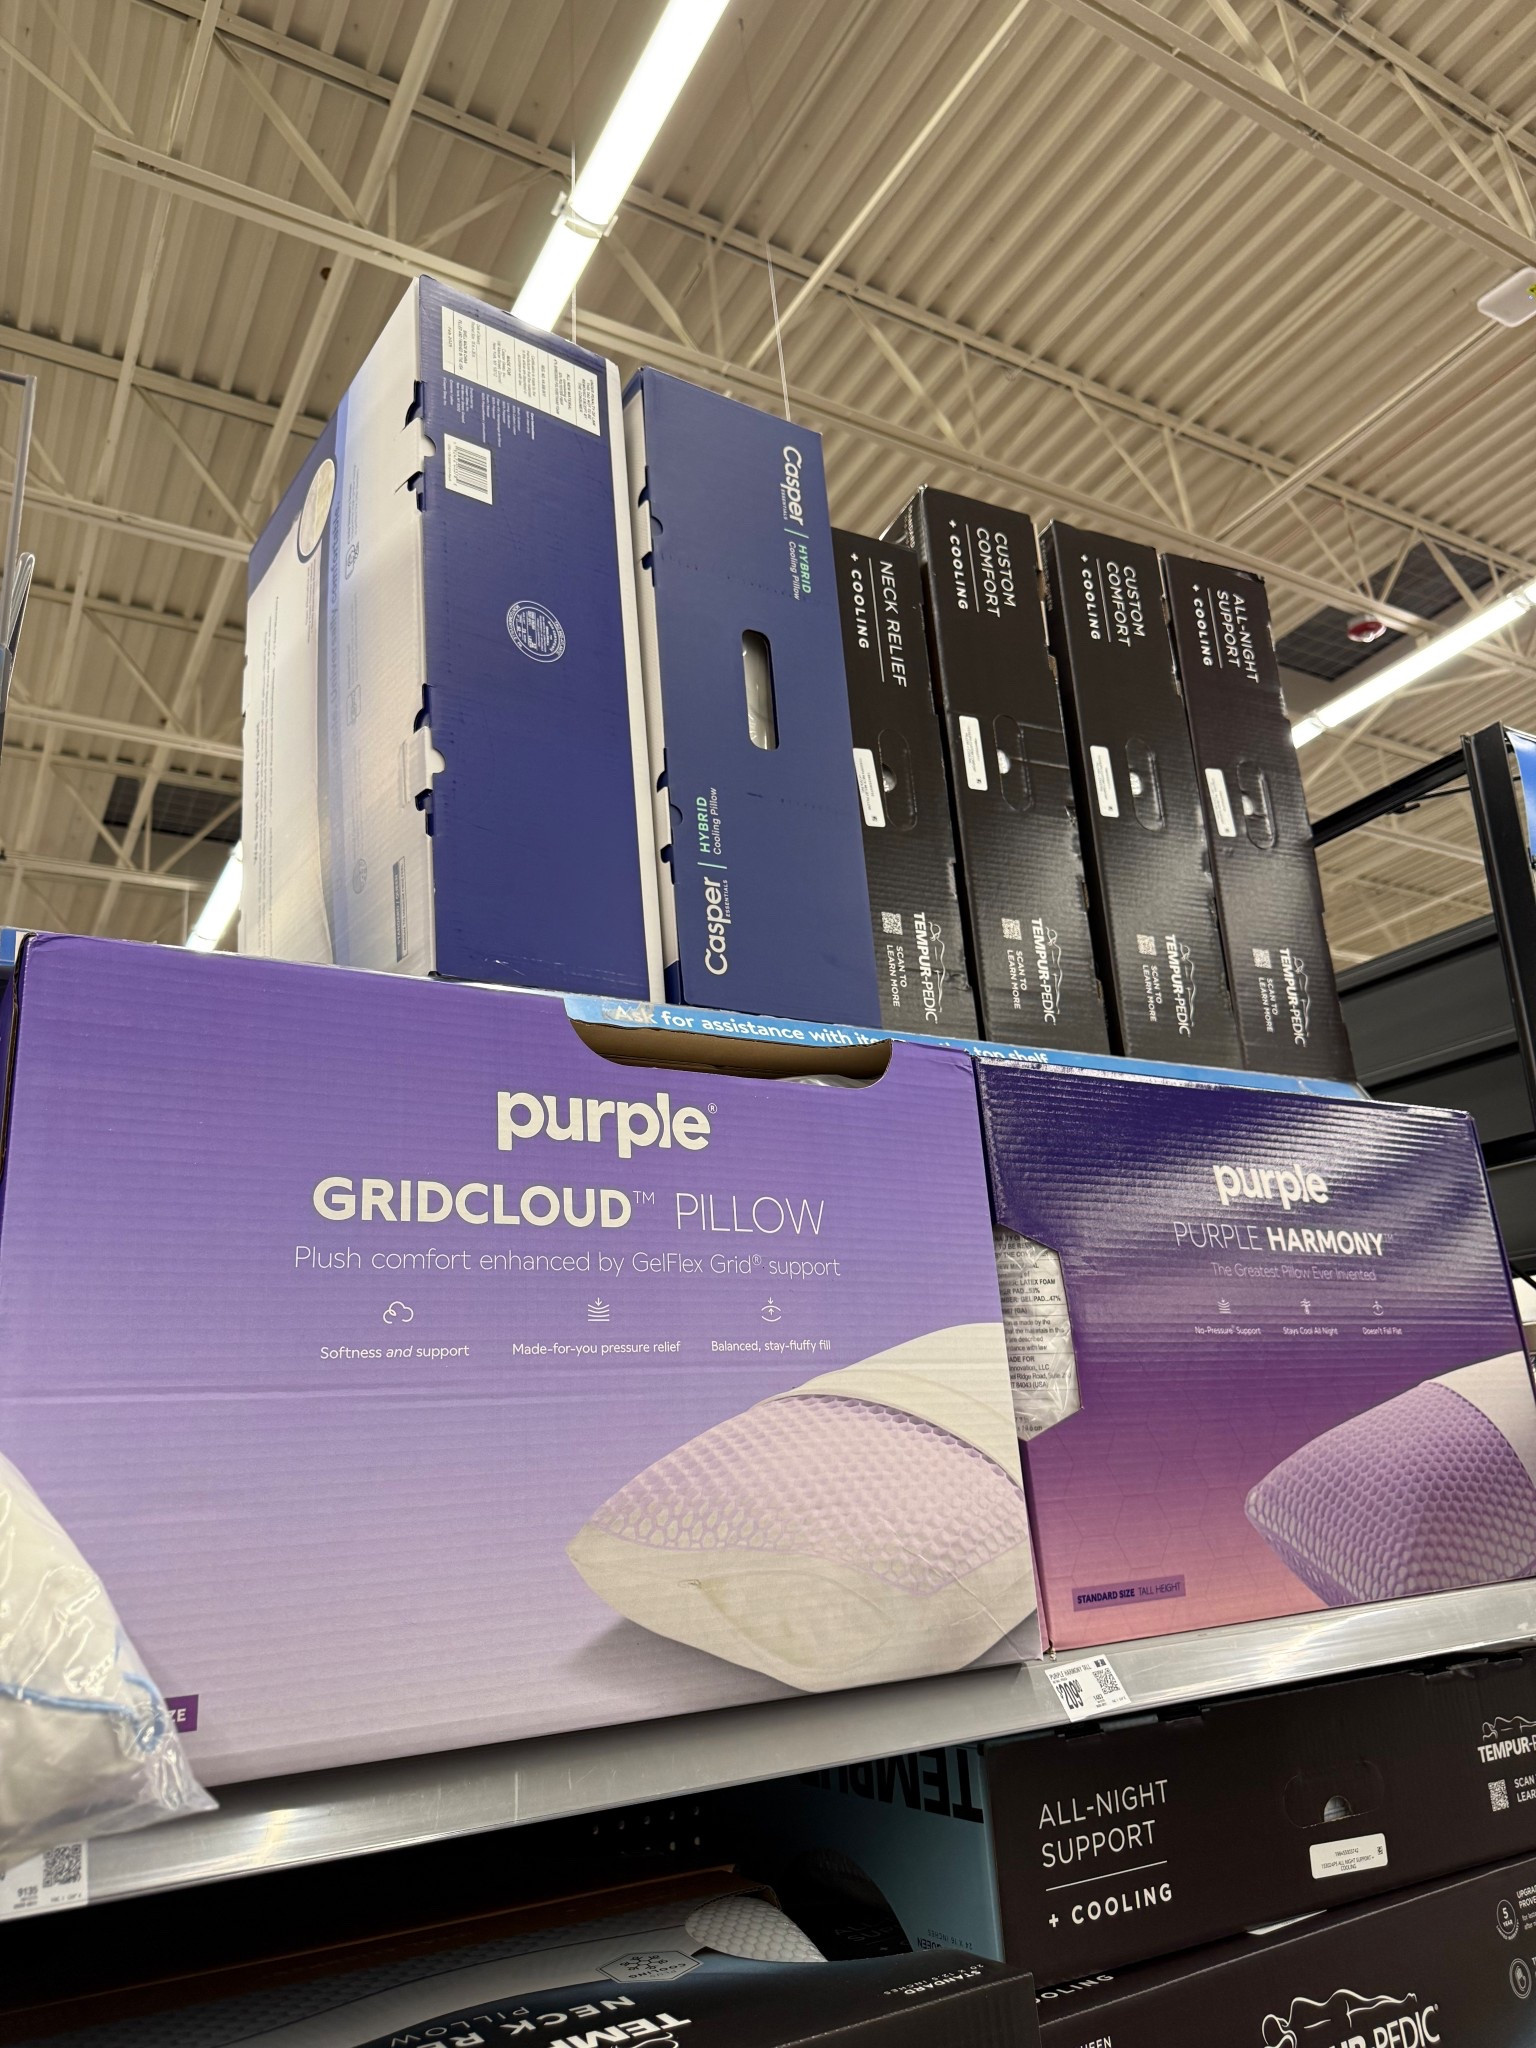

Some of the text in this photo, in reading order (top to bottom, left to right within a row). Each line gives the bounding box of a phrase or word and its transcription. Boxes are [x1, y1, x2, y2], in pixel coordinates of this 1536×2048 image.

[780, 446, 804, 526] Casper
[780, 489, 788, 520] ESSENTIALS
[789, 541, 800, 600] Cooling Pillow
[798, 544, 812, 594] HYBRID
[949, 535, 968, 610] COOLING
[976, 527, 1000, 617] COMFORT
[994, 531, 1016, 607] CUSTOM
[852, 569, 869, 648] COOLING
[1081, 568, 1100, 640] COOLING
[1106, 562, 1130, 646] COMFORT
[1124, 565, 1146, 636] CUSTOM
[880, 560, 907, 687] NECK RELIEF
[1193, 598, 1213, 666] COOLING
[1216, 589, 1240, 668] SUPPORT
[1233, 594, 1258, 683] ALL-NIGHT
[696, 797, 710, 853] HYBRID
[710, 787, 722, 855] Cooling Pillow
[723, 880, 731, 918] ESSENTIALS
[704, 876, 732, 976] Casper
[886, 944, 900, 1008] LEARN MORE
[896, 946, 908, 988] SCAN TO
[914, 912, 937, 1024] TEMPUR-PEDIC
[1007, 950, 1021, 1010] LEARN MORE
[1016, 950, 1028, 990] SCAN TO
[1032, 918, 1056, 1024] TEMPUR-PEDIC
[1151, 966, 1162, 1004] SCAN TO
[1165, 934, 1190, 1036] TEMPUR-PEDIC
[1142, 964, 1156, 1022] LEARN MORE
[1258, 977, 1273, 1032] LEARN MORE
[1266, 978, 1278, 1016] SCAN TO
[1279, 948, 1306, 1046] TEMPUR-PEDIC
[614, 1004, 658, 1024] Ask
[662, 1011, 694, 1028] for
[702, 1016, 806, 1041] assistance
[808, 1026, 852, 1046] with
[1212, 1164, 1329, 1210] purple
[676, 1192, 825, 1236] PILLOW
[1173, 1221, 1263, 1250] PURPLE
[295, 1245, 362, 1270] Plush
[371, 1247, 472, 1272] comfort
[479, 1250, 591, 1272] enhanced
[599, 1250, 625, 1278] by
[631, 1251, 704, 1274] GelFlex
[769, 1256, 841, 1280] support
[1211, 1262, 1377, 1281] The Greatest Pillow Ever Invented
[320, 1344, 470, 1361] Softness and support
[512, 1340, 682, 1358] Made-for-you pressure relief
[711, 1339, 832, 1354] Balanced, stay-fluffy fill
[1236, 1326, 1262, 1336] Support
[1282, 1326, 1300, 1336] Stays
[1300, 1326, 1314, 1334] Cool
[1322, 1326, 1338, 1336] Night
[1362, 1326, 1383, 1335] Doesn't
[1077, 1582, 1181, 1604] STANDARD SIZE TALL HEIGHT
[1514, 1774, 1534, 1790] SCAN
[1038, 1778, 1170, 1831] ALL-NIGHT
[1041, 1818, 1157, 1870] SUPPORT
[1356, 1854, 1372, 1864] SUPPORT
[1340, 1864, 1356, 1872] COOLING
[1070, 1882, 1174, 1926] COOLING
[1502, 1907, 1509, 1920] 5
[1502, 1919, 1514, 1928] YEAR
[927, 1928, 950, 1944] INCHES
[964, 1940, 974, 1951] 24
[628, 1960, 686, 1980] COOLING
[882, 1976, 928, 1996] INCHES
[903, 1969, 982, 1996] STANDARD
[390, 2006, 530, 2048] PILLOW
[500, 1995, 636, 2036] NECK
